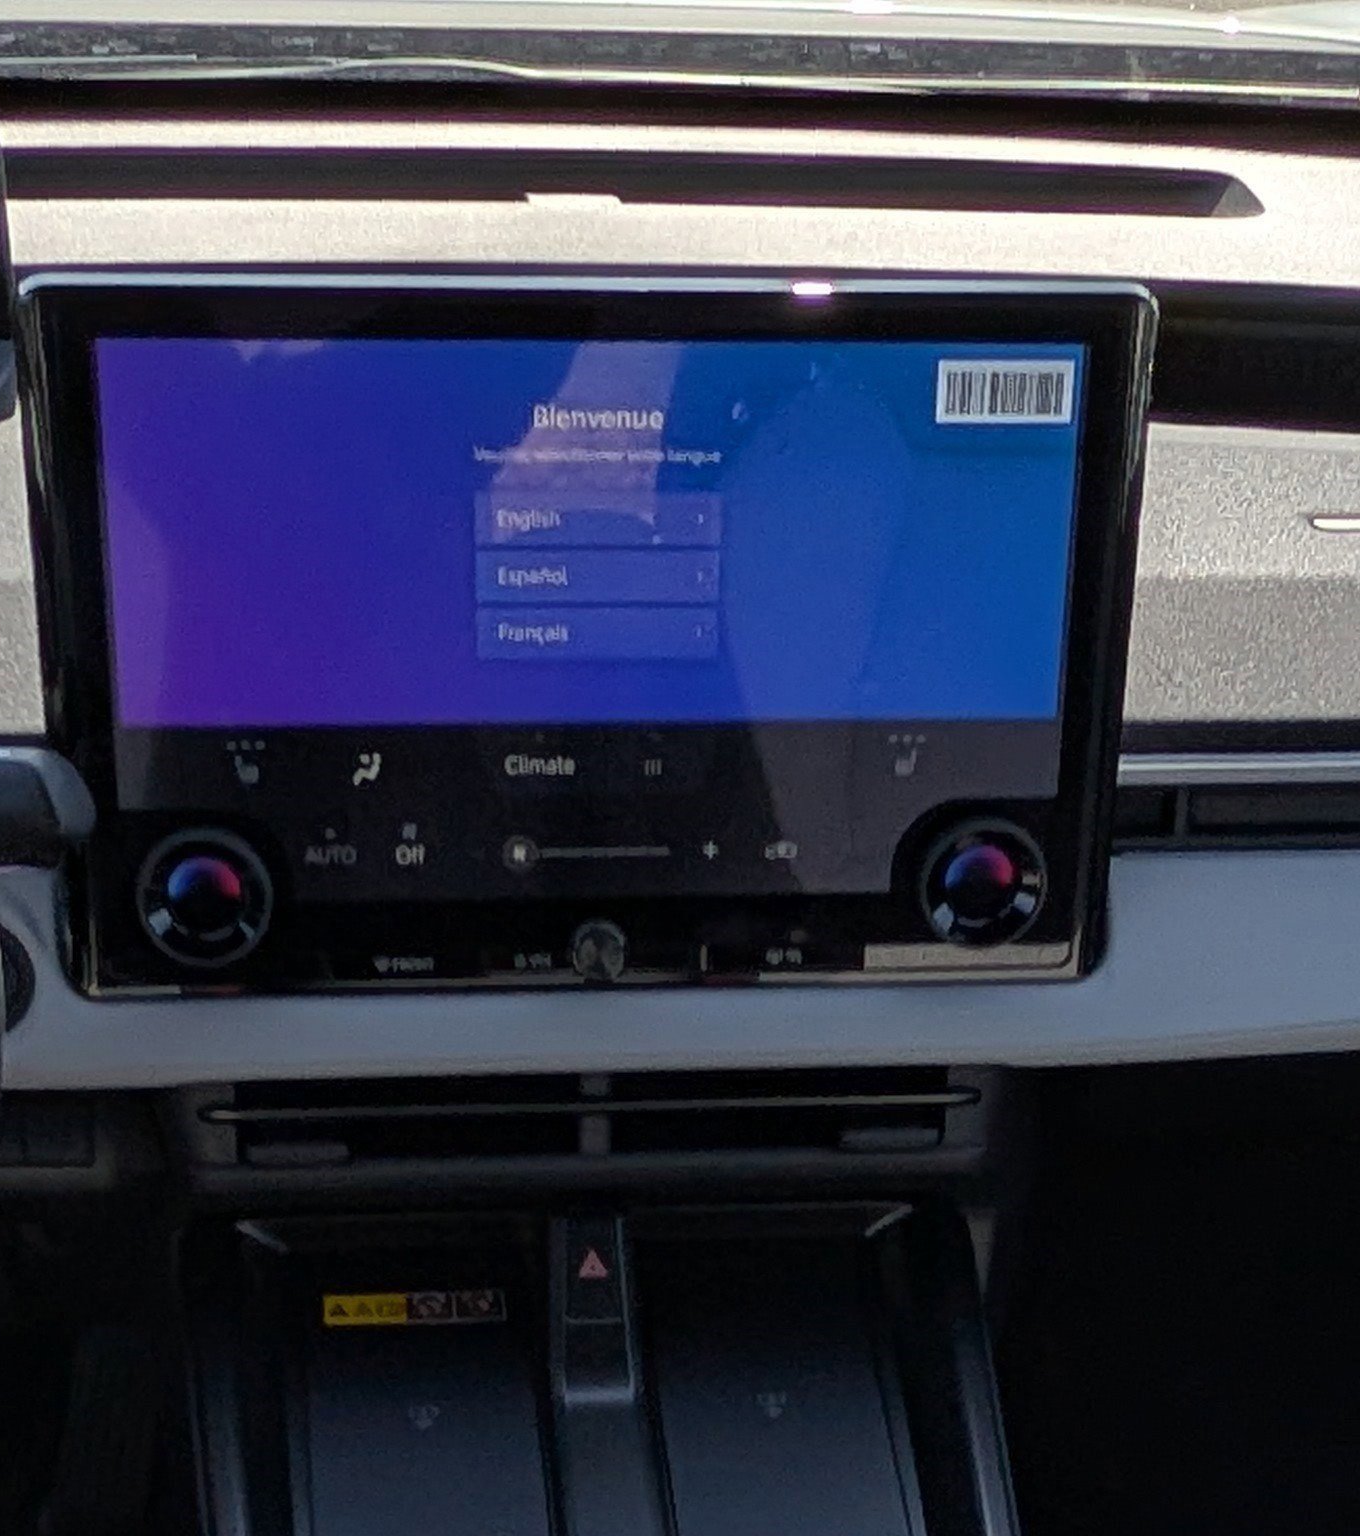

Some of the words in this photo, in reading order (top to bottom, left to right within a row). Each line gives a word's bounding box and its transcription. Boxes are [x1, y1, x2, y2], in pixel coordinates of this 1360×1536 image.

[533, 404, 664, 430] Bienvenue
[497, 509, 561, 532] English
[497, 565, 568, 587] Español
[497, 620, 569, 645] Français
[504, 754, 575, 776] Climate
[305, 845, 358, 866] AUTO
